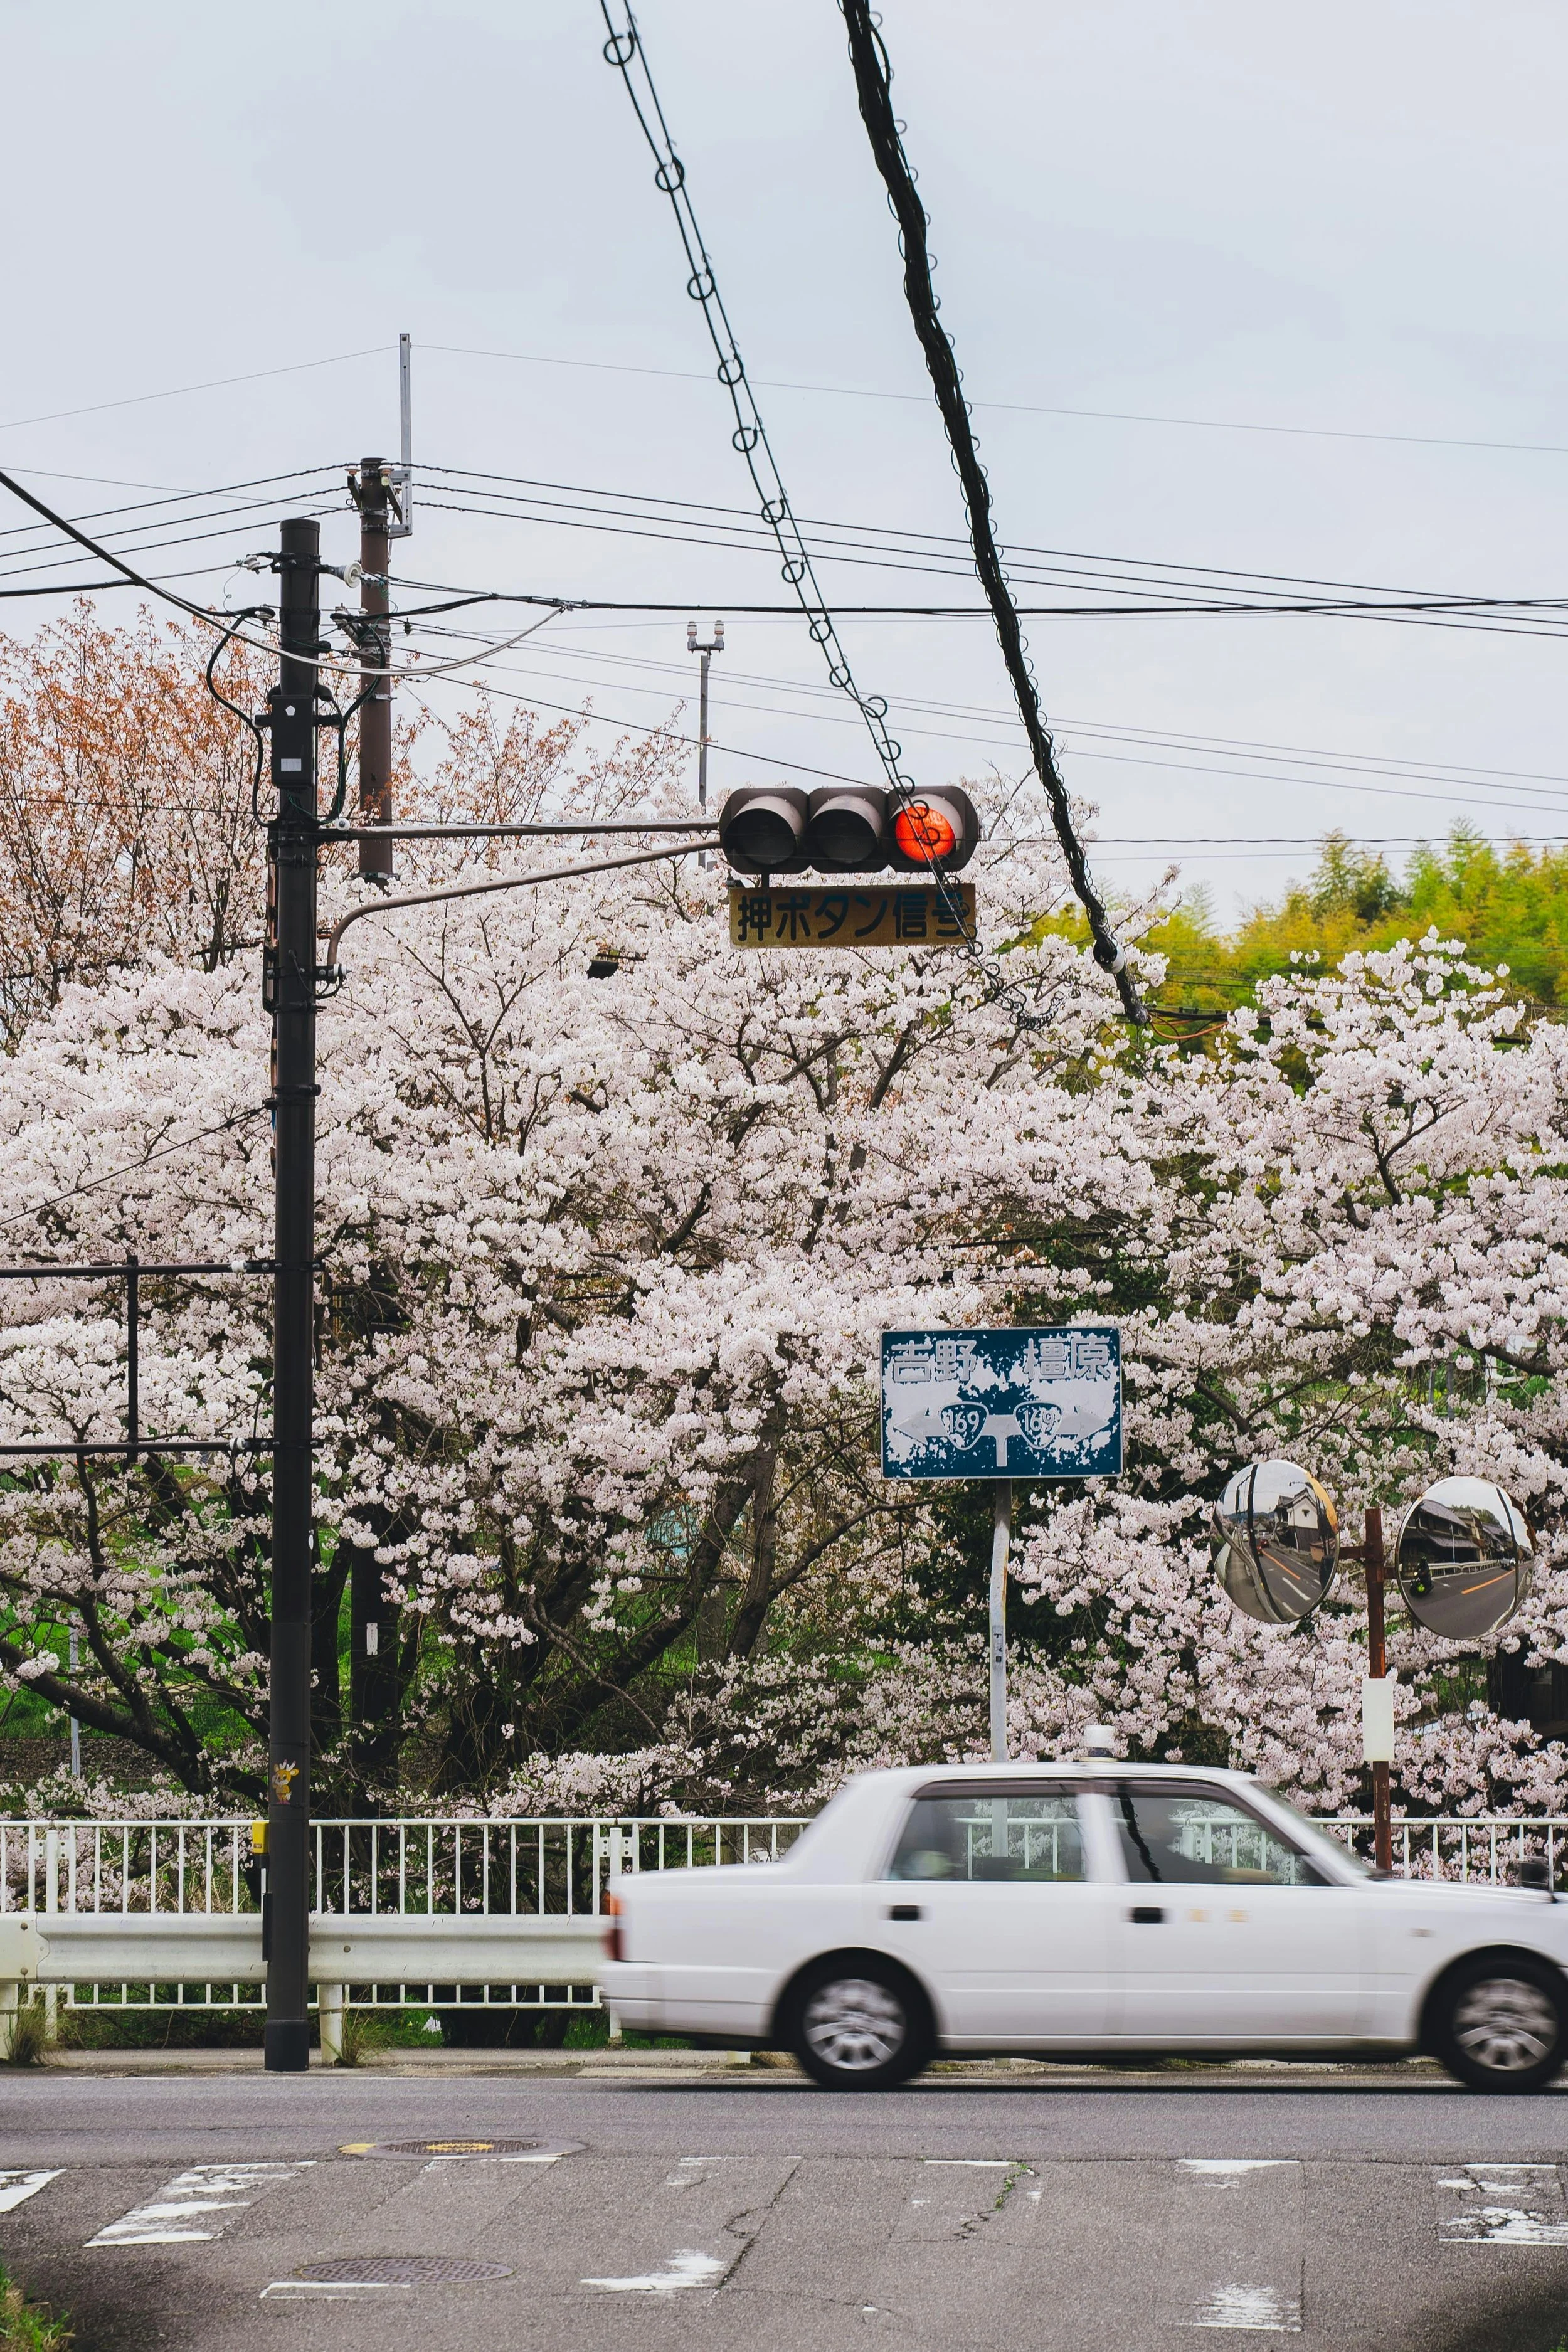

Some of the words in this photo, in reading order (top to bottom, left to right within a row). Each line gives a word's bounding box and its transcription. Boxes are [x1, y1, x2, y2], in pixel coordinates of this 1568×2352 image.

[738, 893, 967, 941] 押ボタン信号
[891, 1339, 978, 1382] 吉野
[1023, 1337, 1111, 1380] 橿原
[948, 1411, 980, 1433] 169
[1024, 1411, 1056, 1433] 169
